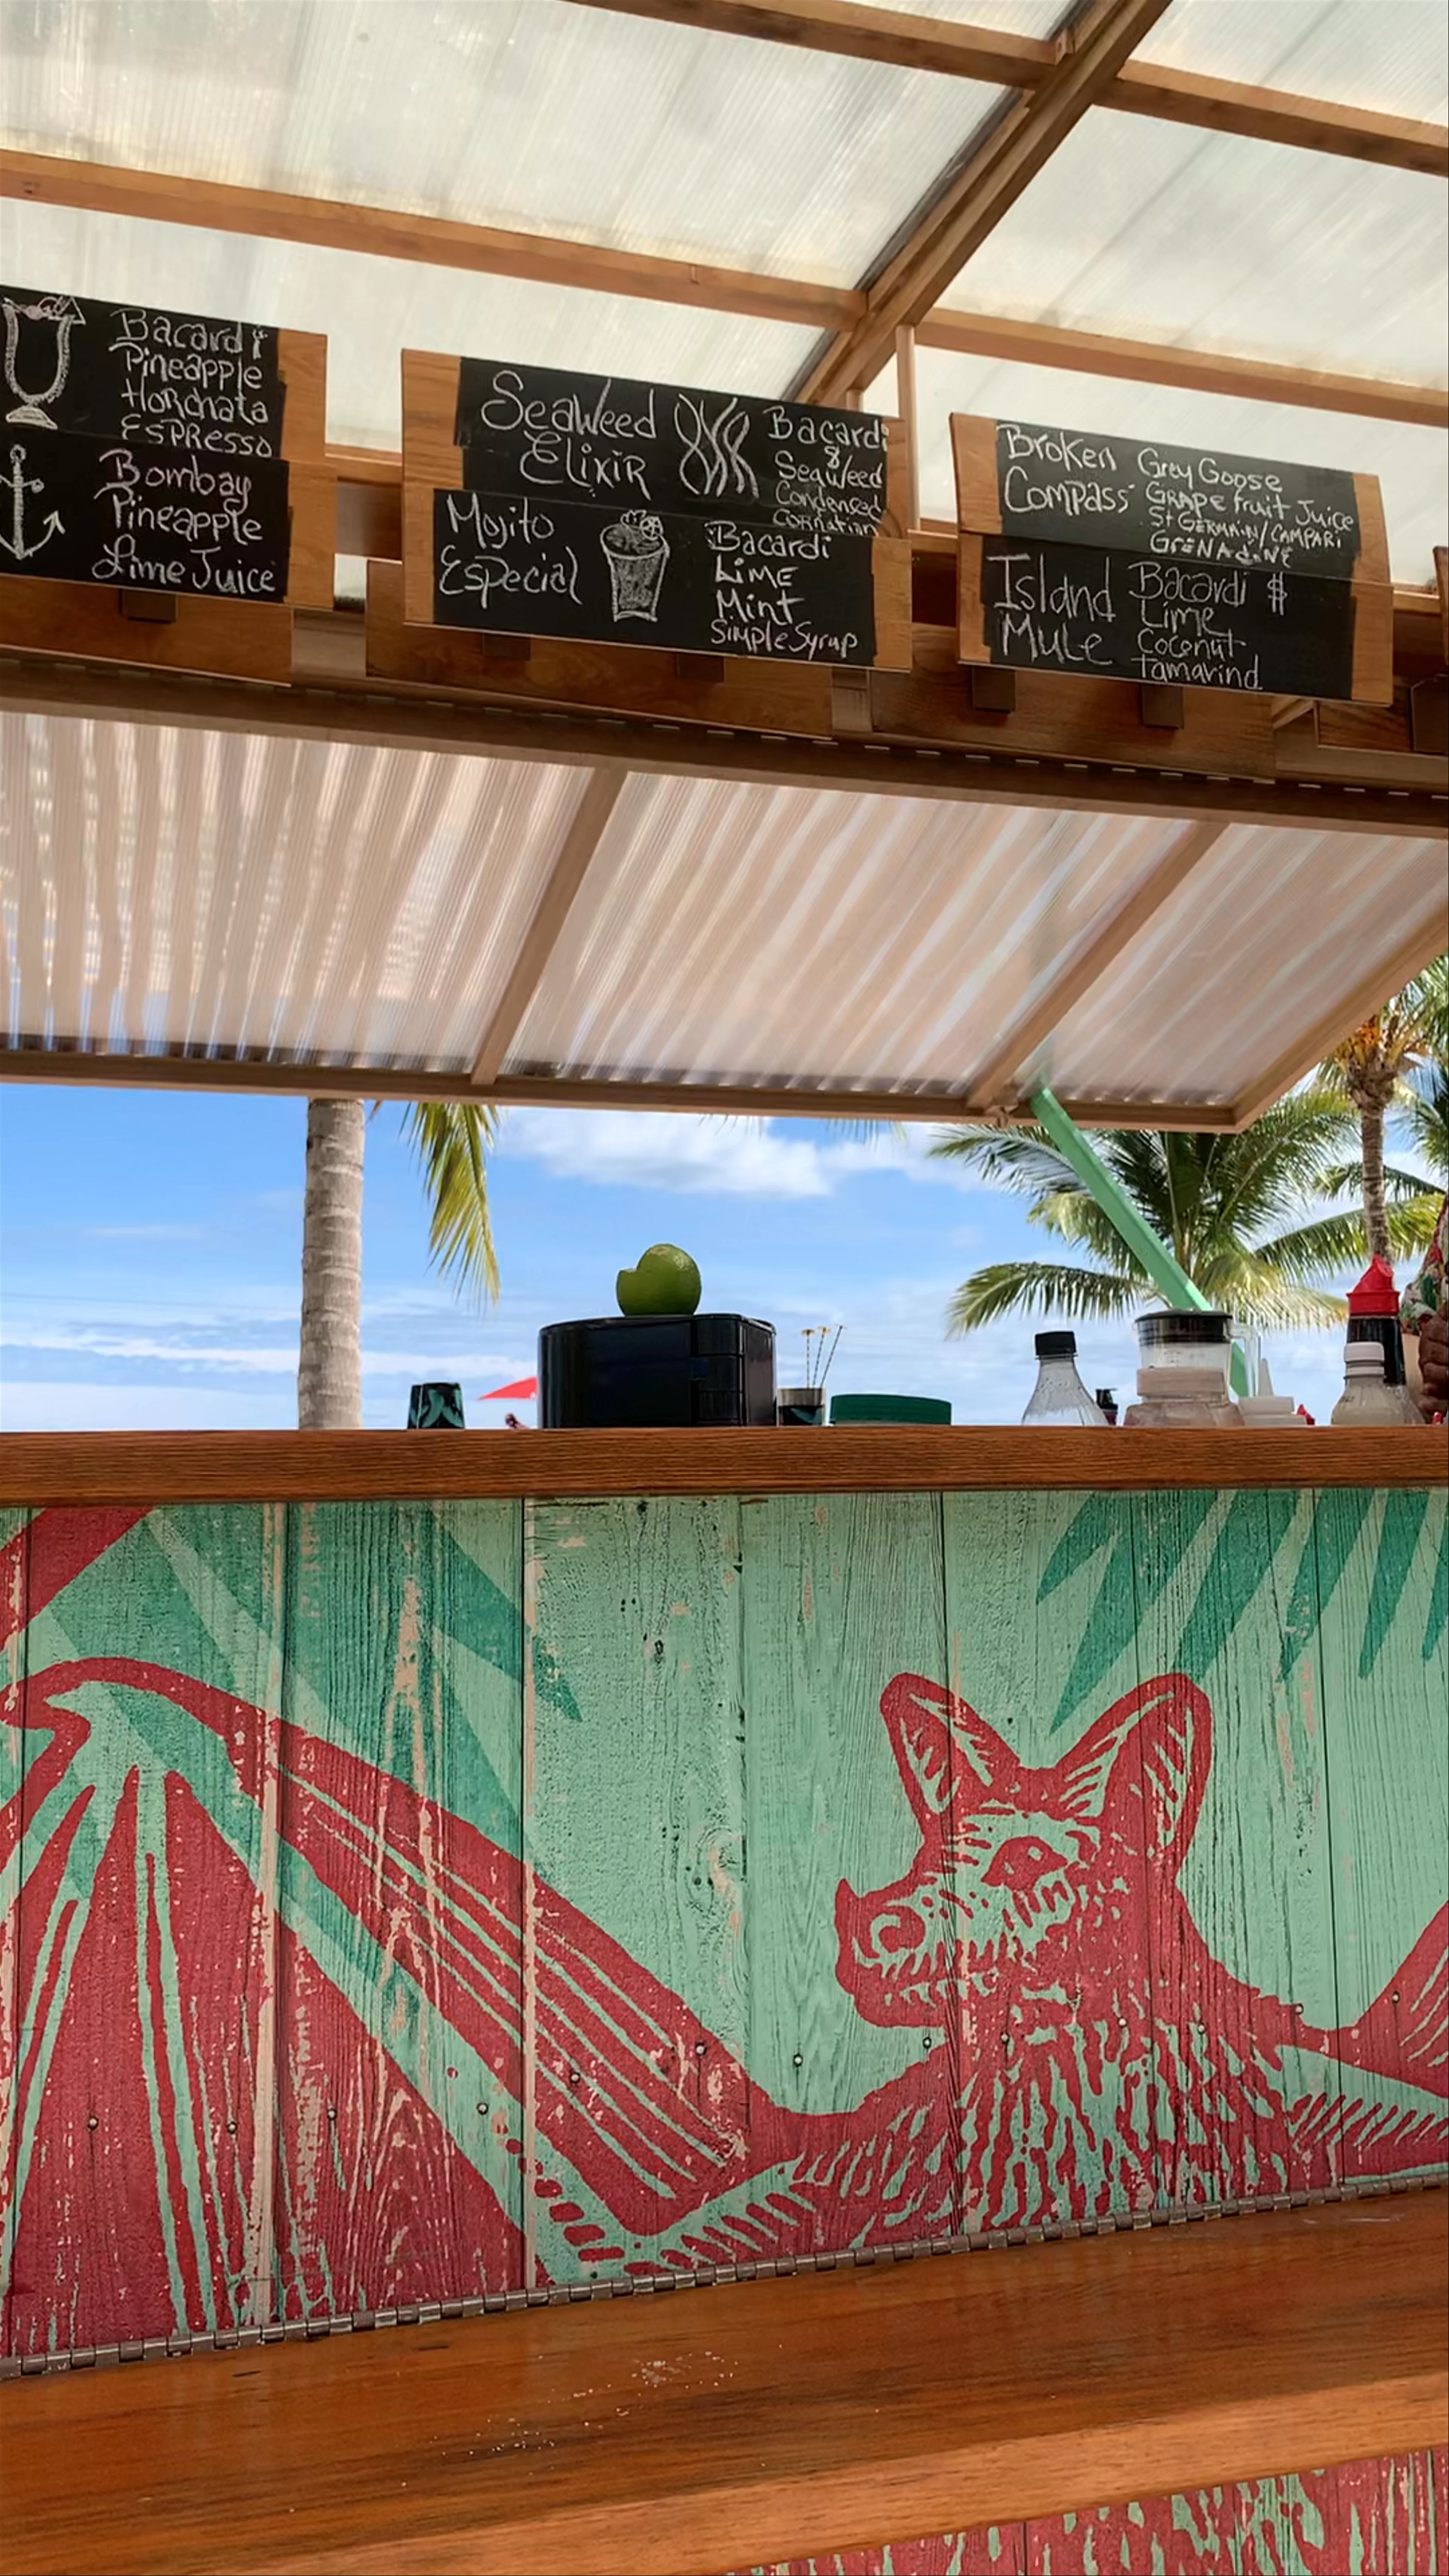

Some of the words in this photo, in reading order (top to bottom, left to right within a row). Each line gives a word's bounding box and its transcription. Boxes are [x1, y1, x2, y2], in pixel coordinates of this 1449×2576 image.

[109, 342, 263, 390] Pineapple
[763, 405, 889, 452] Bacardi
[99, 448, 252, 516] Bombay
[1137, 448, 1193, 490] Grey
[1198, 457, 1283, 492] Goose
[93, 483, 263, 546] Pineapple
[446, 493, 554, 549] Mojito
[1295, 500, 1354, 531] Juice
[704, 520, 832, 560] Bacardi
[91, 533, 186, 585] Lime
[190, 546, 275, 595] Juice
[986, 552, 1117, 623] Island
[1128, 561, 1249, 608] Bacardi
[716, 587, 805, 626] Mint
[1141, 598, 1233, 637] Lime
[788, 620, 858, 661] Syrup
[1137, 627, 1247, 662] Coconut
